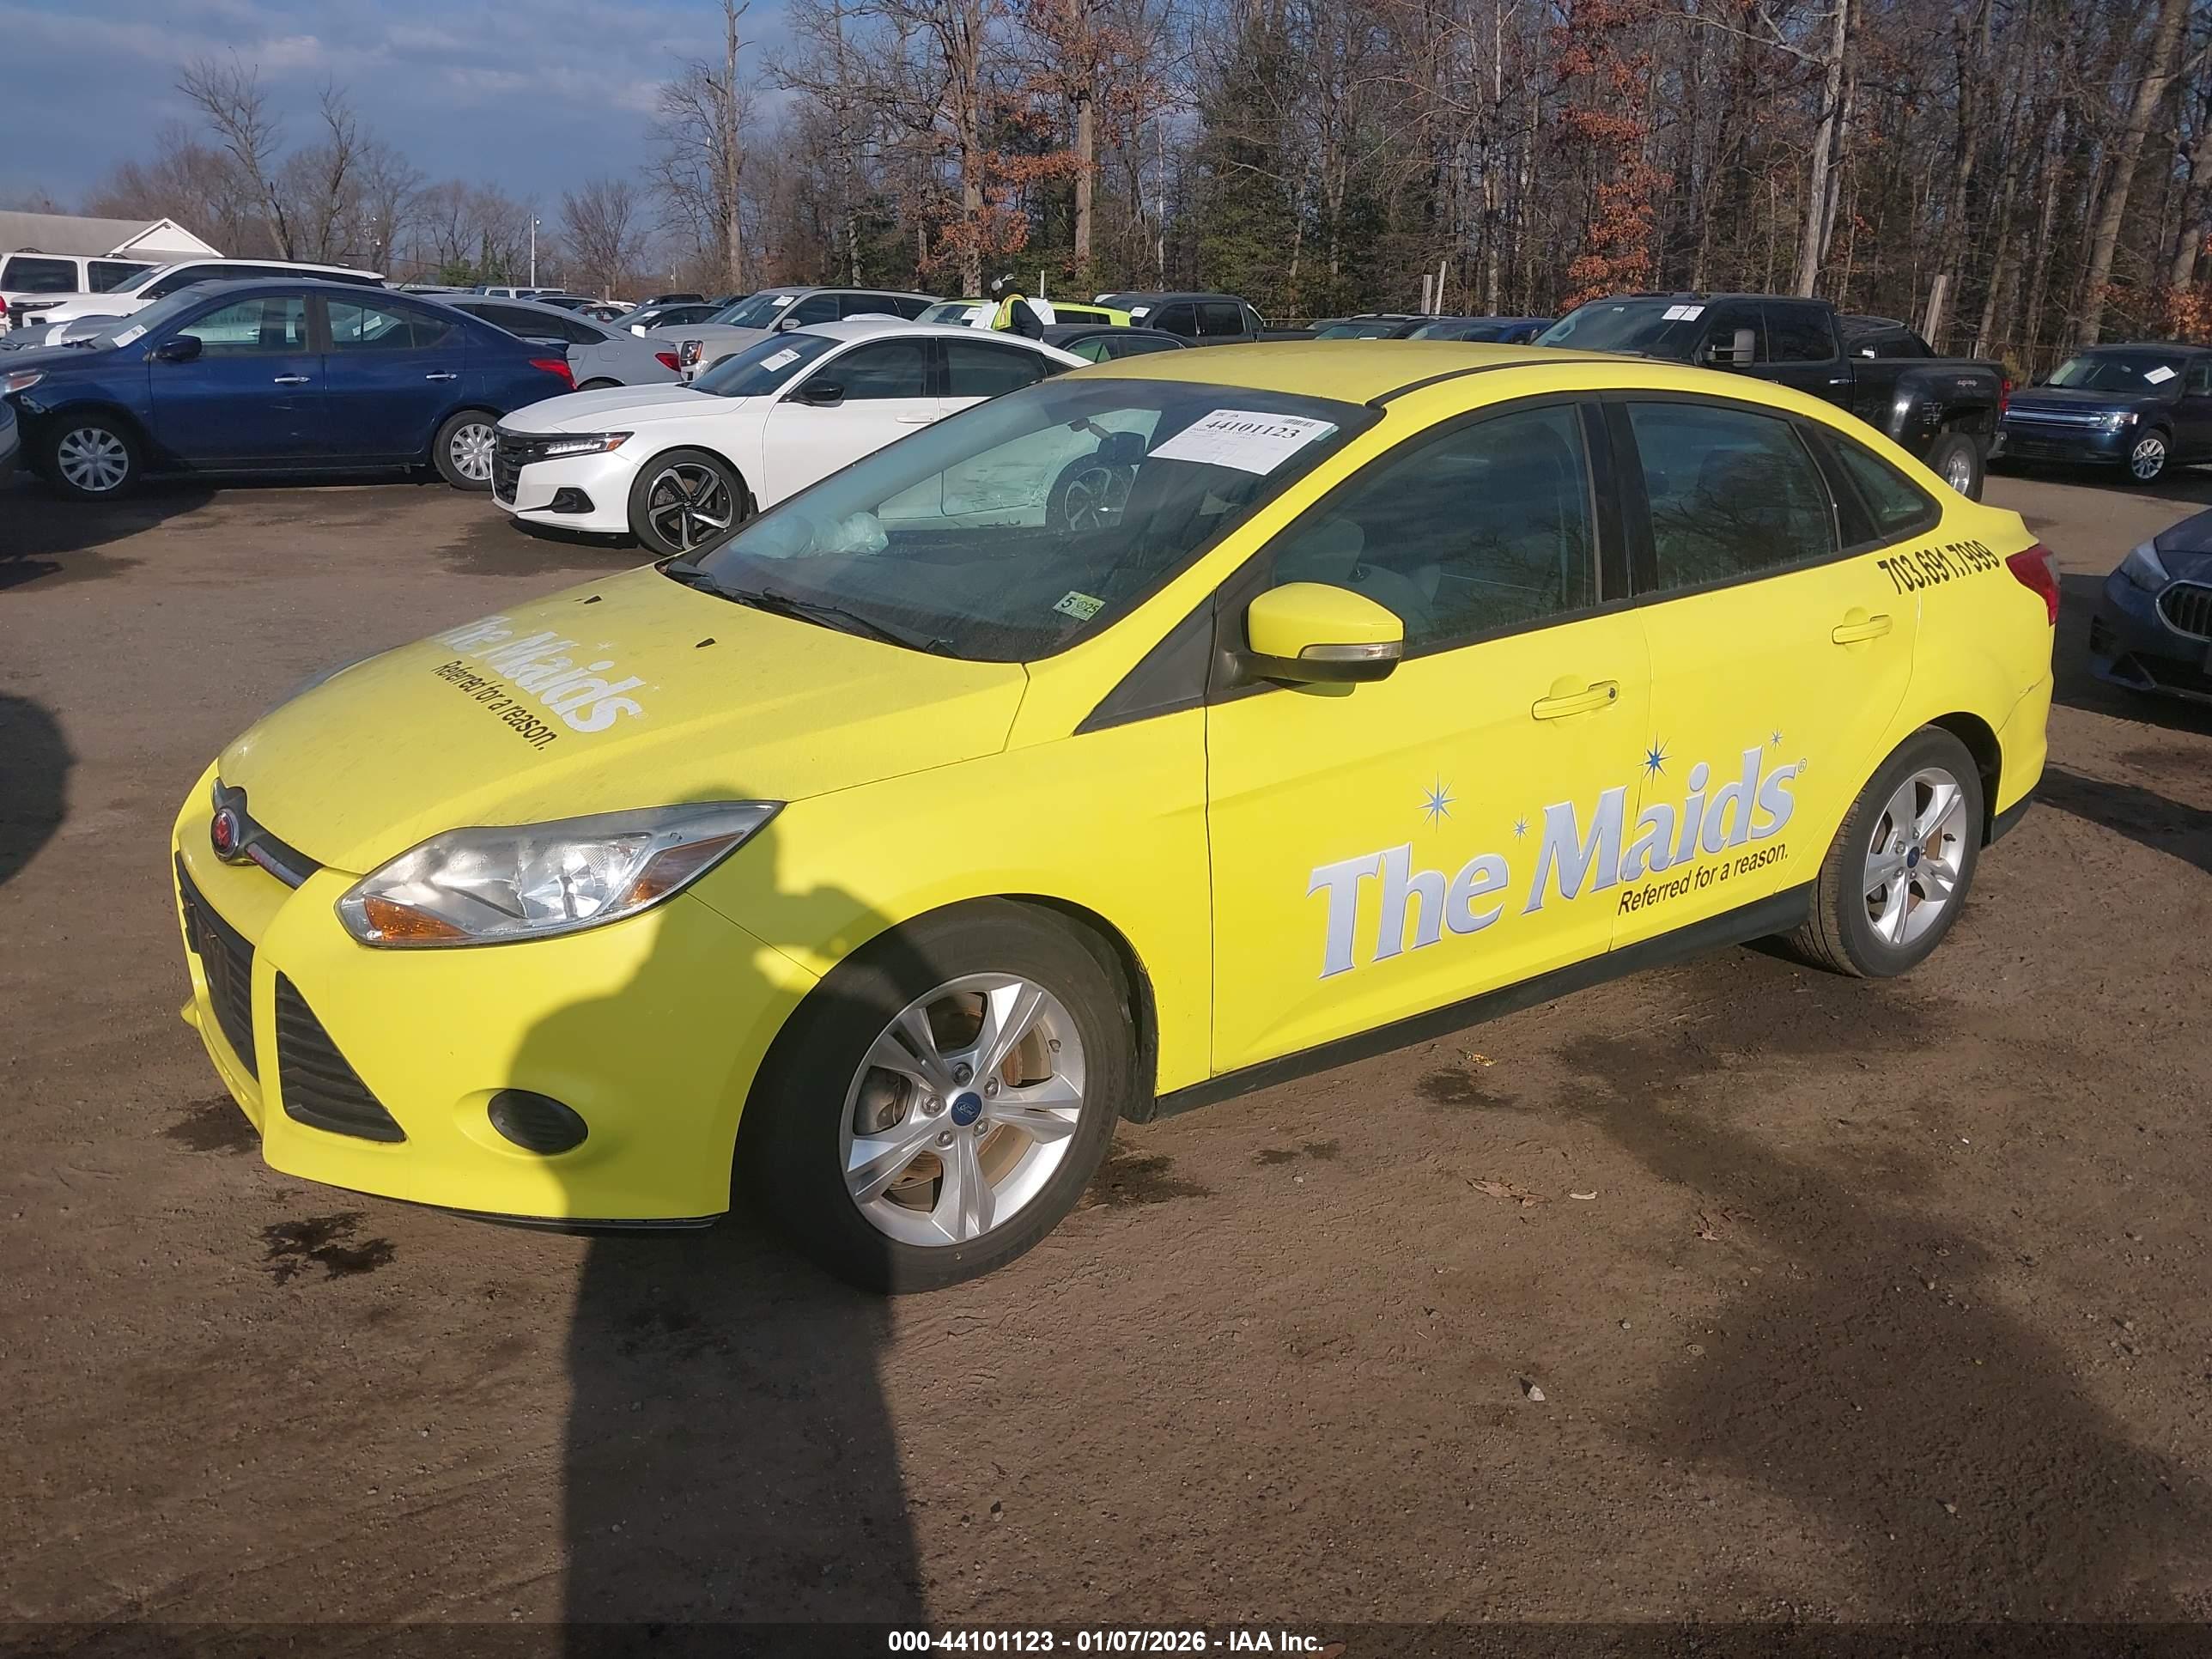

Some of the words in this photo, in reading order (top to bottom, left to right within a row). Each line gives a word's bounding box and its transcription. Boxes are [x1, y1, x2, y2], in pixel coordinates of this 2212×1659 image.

[1206, 420, 1300, 439] 44101123
[1876, 540, 2000, 594] 703.691.7999
[1061, 597, 1077, 608] 5
[1084, 603, 1099, 614] 25
[430, 659, 496, 694] Referred
[471, 684, 506, 704] for
[487, 699, 513, 712] a
[496, 705, 557, 751] reason.
[1618, 869, 1692, 916] Referred
[1693, 866, 1718, 890] for
[1720, 862, 1730, 881] a
[1734, 843, 1789, 877] reason.
[1305, 842, 1509, 980] The
